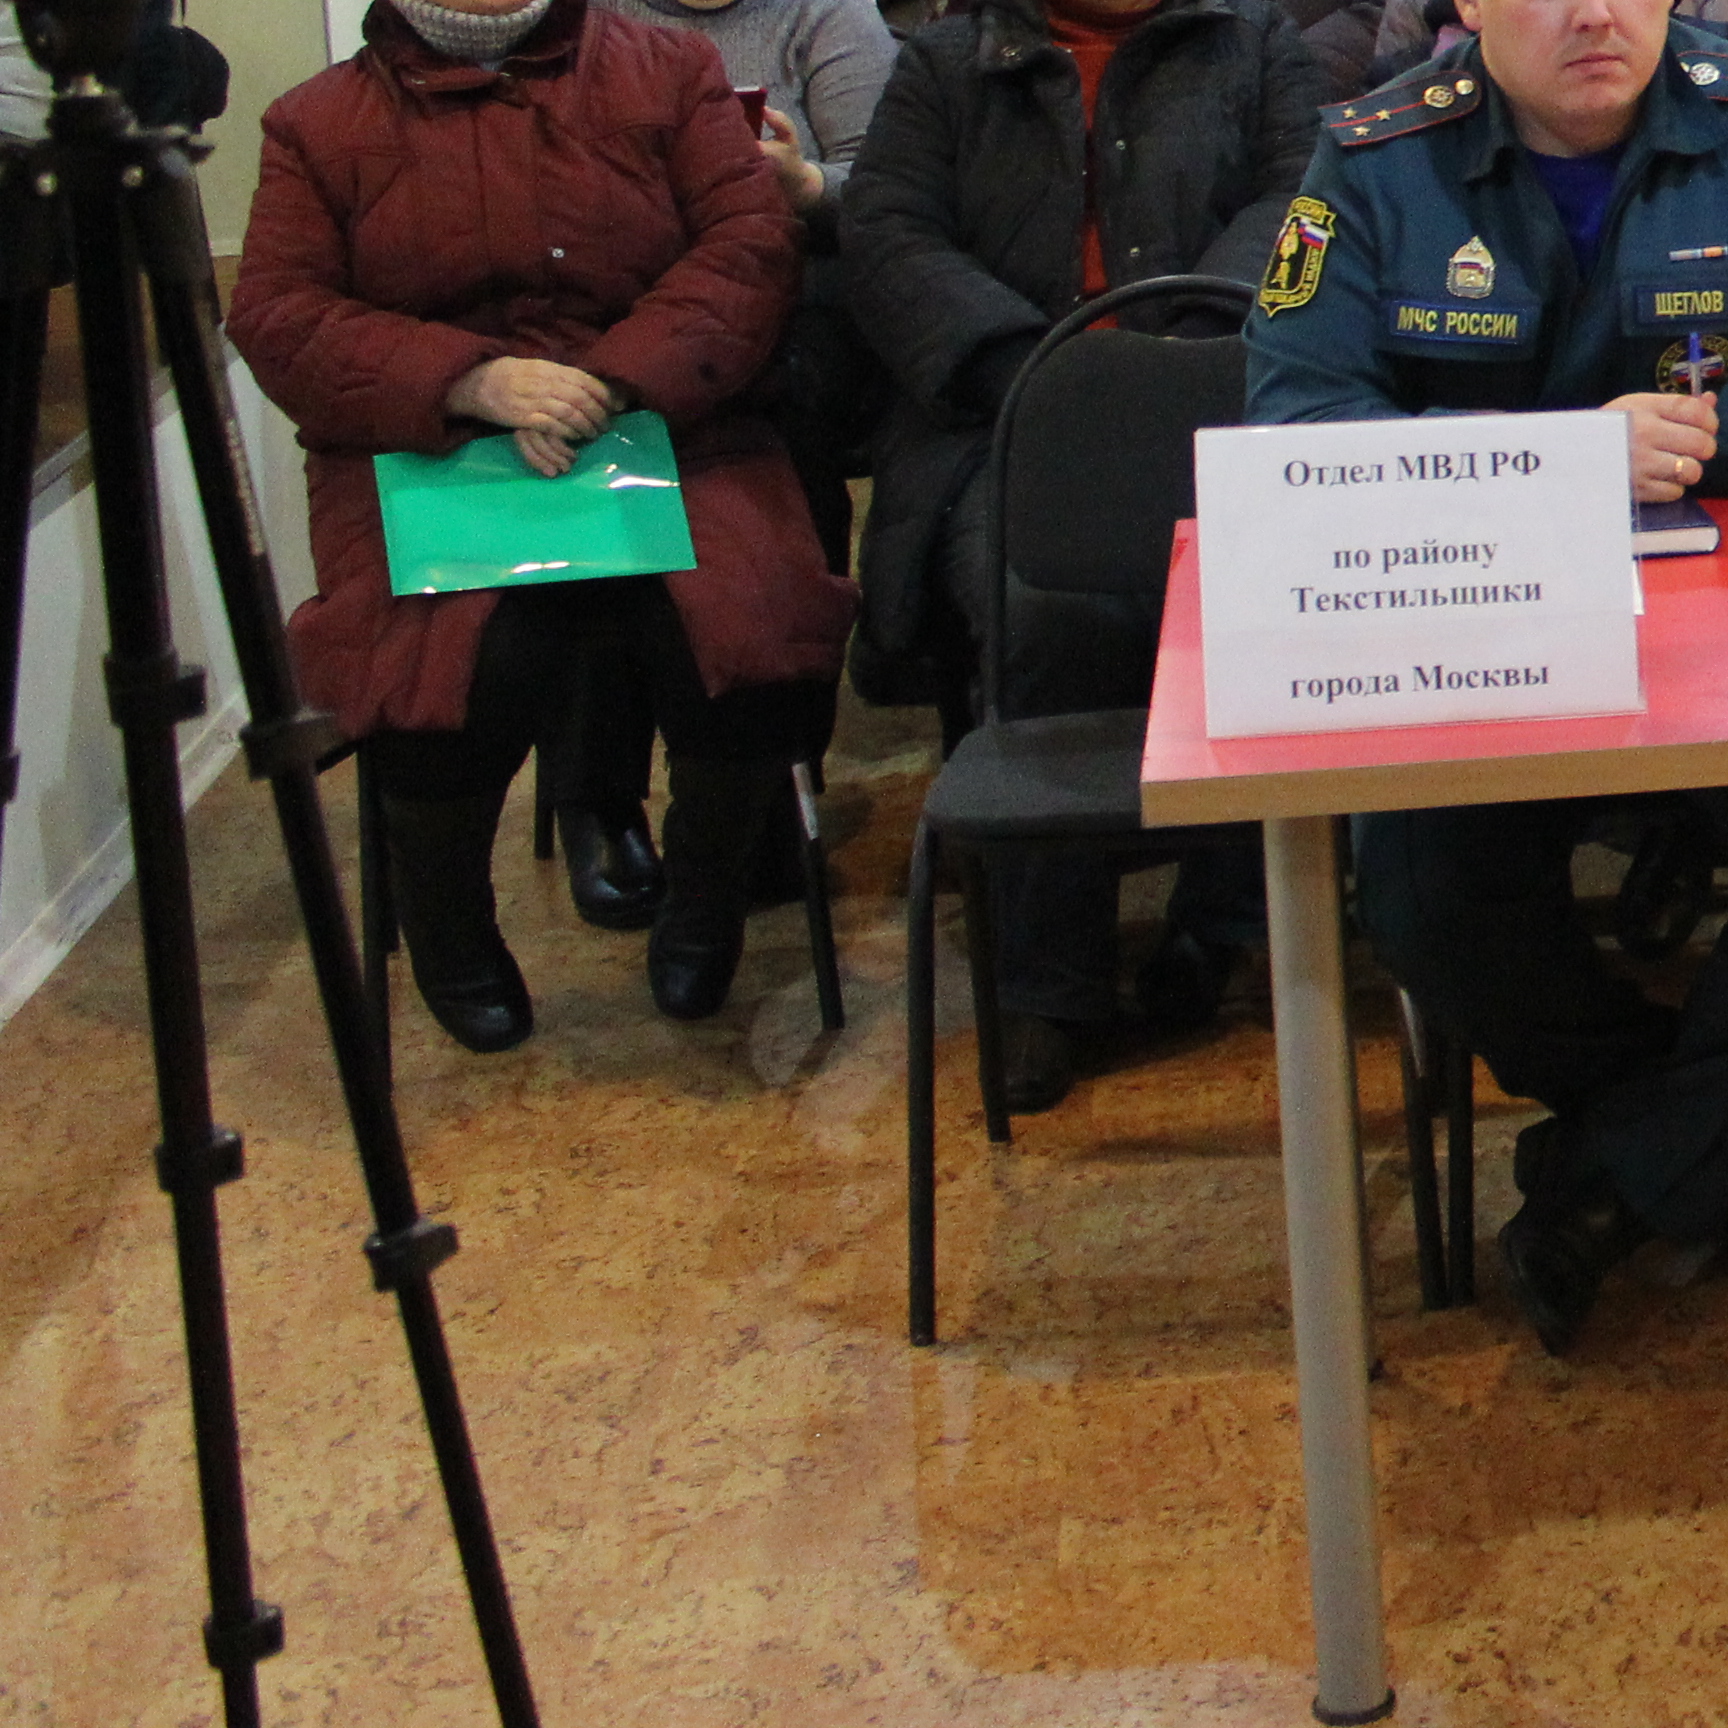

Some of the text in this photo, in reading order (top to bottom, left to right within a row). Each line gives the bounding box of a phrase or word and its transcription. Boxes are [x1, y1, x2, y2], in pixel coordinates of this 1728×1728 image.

[1655, 290, 1724, 319] ЩЕГЛОВ
[1397, 306, 1518, 338] МЧС РОССИИ
[1283, 449, 1541, 487] Отдел МВД РФ
[1333, 539, 1499, 573] по району
[1291, 582, 1542, 613] Текстильщики
[1290, 664, 1549, 704] города Москвы
